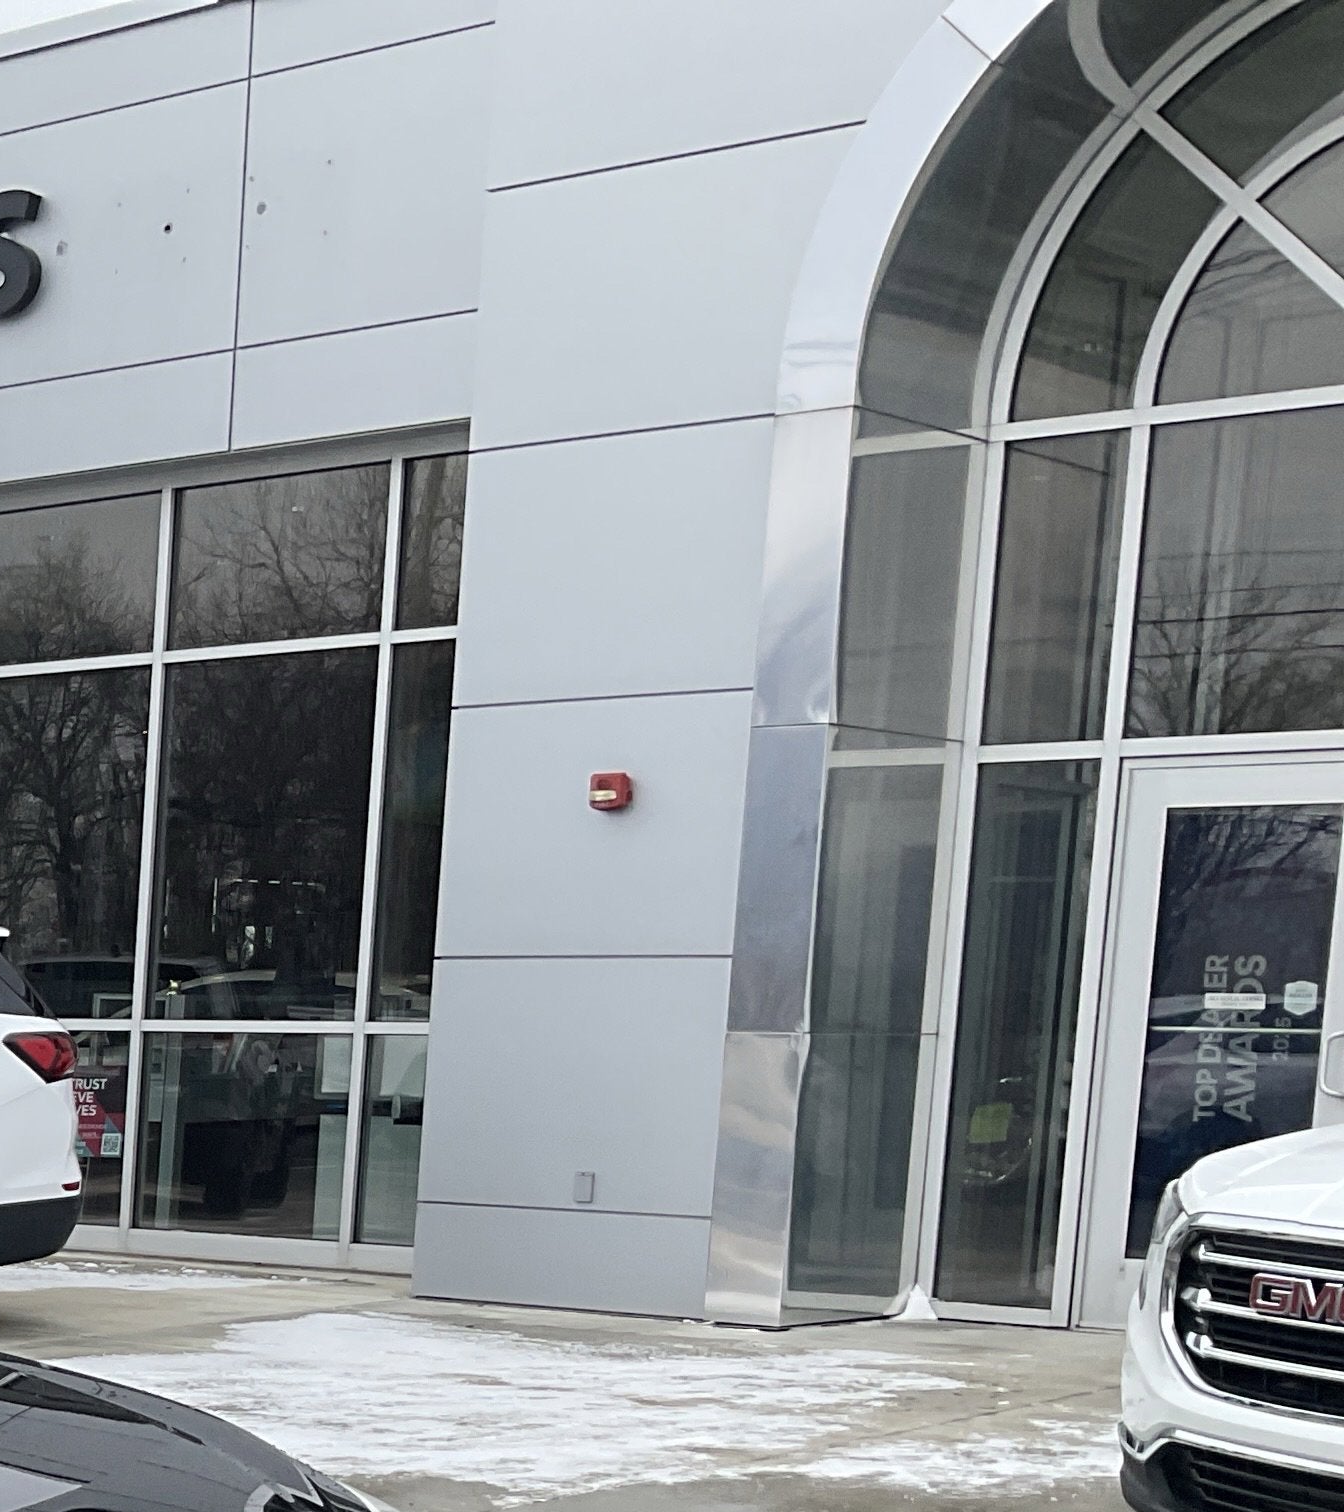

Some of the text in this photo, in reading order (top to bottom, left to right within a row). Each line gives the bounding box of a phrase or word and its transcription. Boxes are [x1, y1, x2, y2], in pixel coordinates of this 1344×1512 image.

[1193, 954, 1229, 1123] TOP DEAER
[1248, 1272, 1344, 1325] GM
